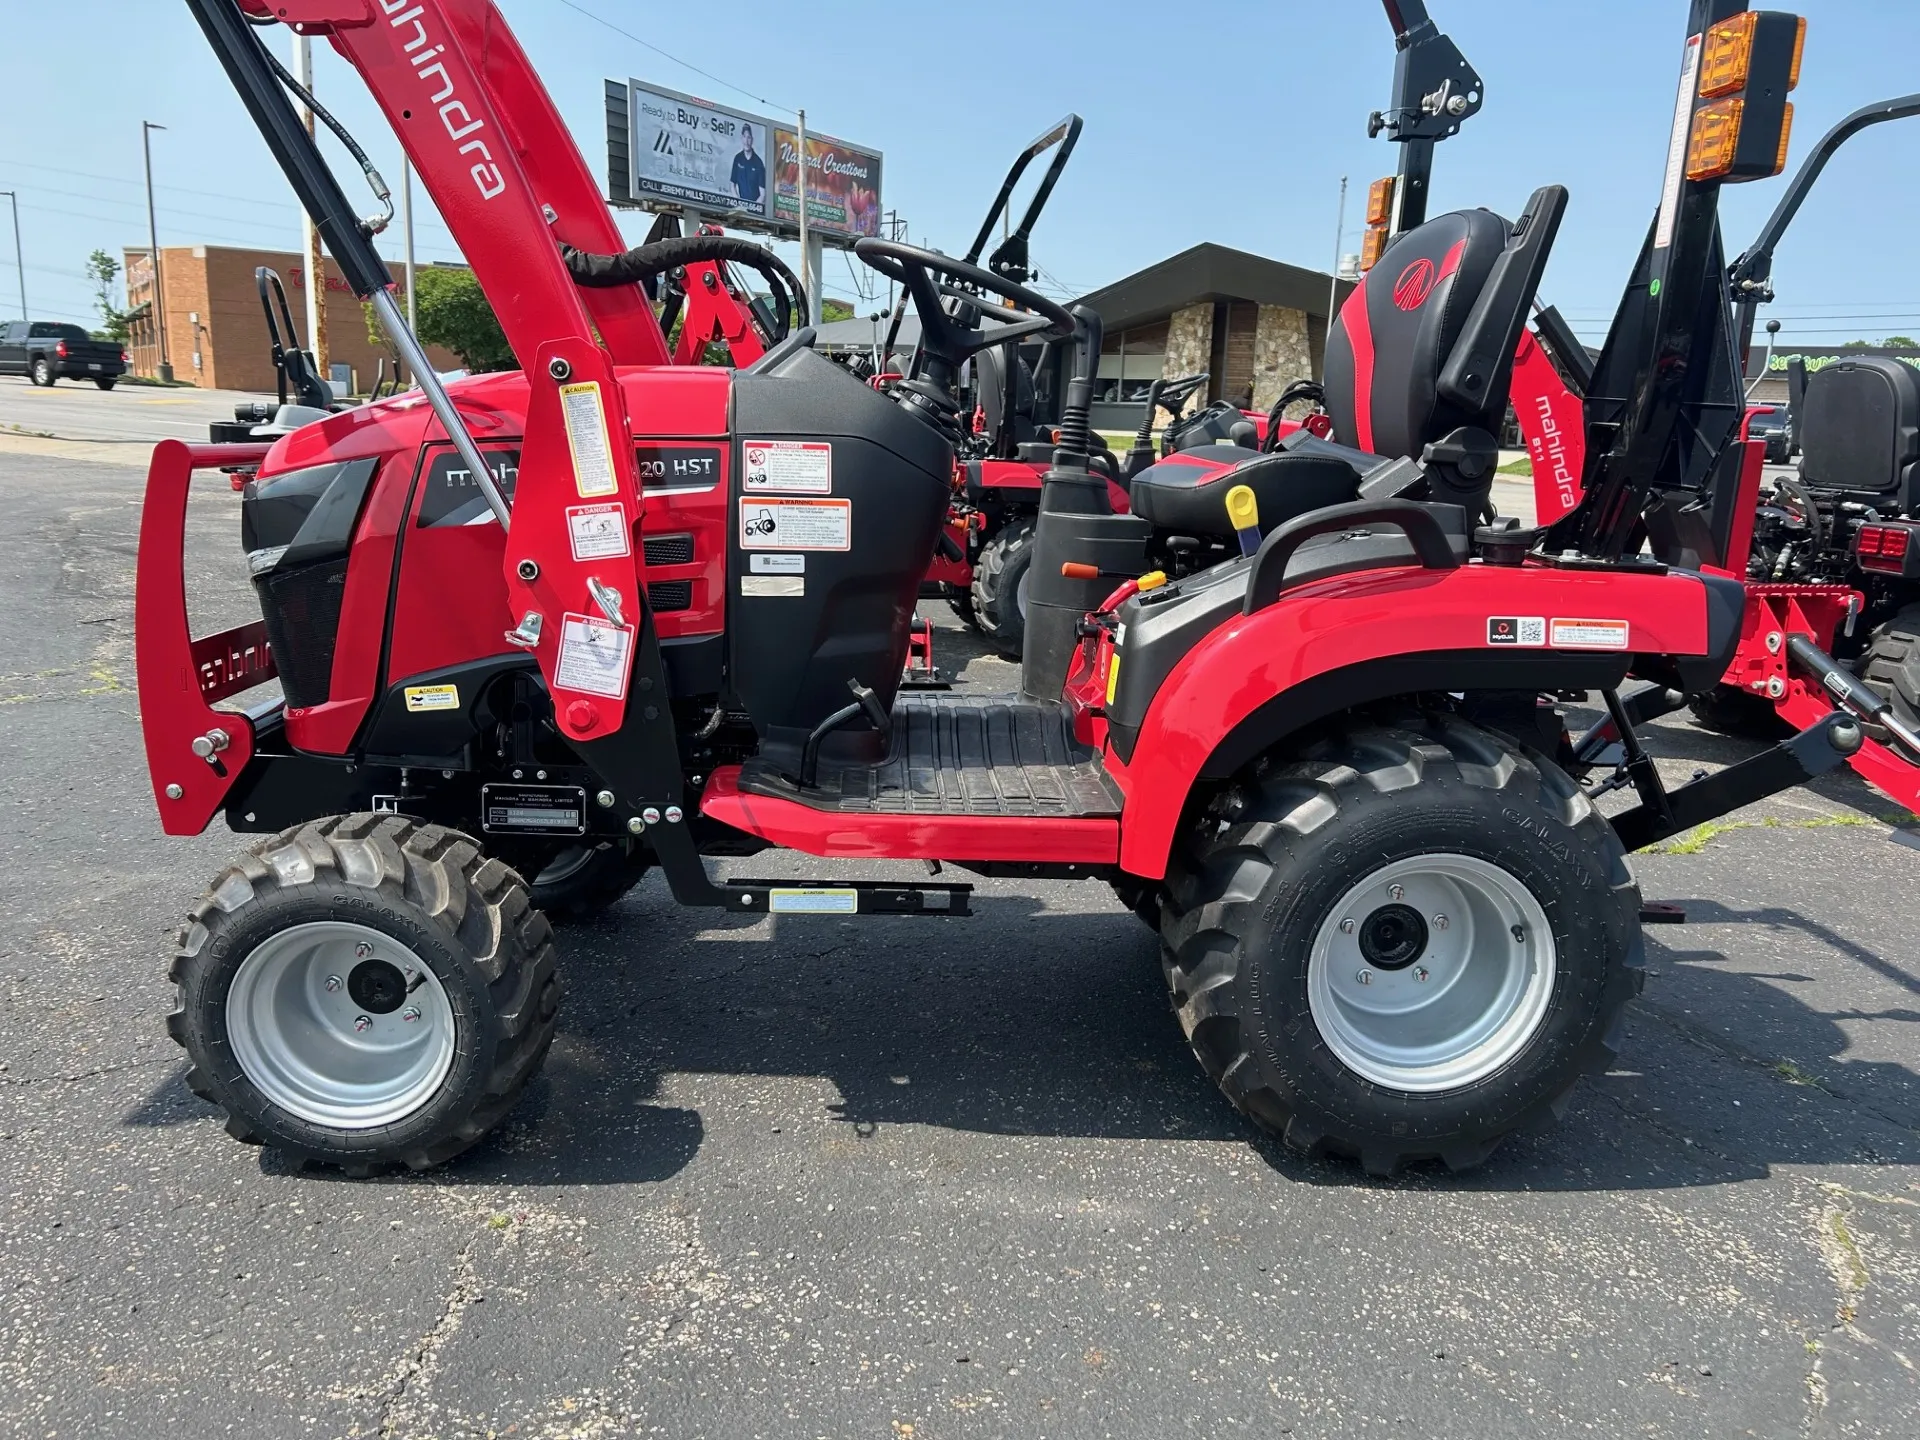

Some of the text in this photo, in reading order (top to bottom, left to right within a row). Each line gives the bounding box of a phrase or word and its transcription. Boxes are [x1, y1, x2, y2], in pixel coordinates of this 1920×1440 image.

[641, 102, 666, 121] Ready
[668, 111, 676, 122] to
[677, 107, 699, 130] Buy
[710, 117, 736, 137] Sell?
[678, 135, 714, 155] MILLS
[780, 142, 869, 179] Naral Creations
[641, 180, 659, 192] CALL
[660, 183, 685, 198] JEREMY
[685, 189, 704, 201] MILLS
[777, 195, 799, 206] NURSER
[806, 201, 827, 213] PENING
[569, 385, 595, 393] CAUTION
[1535, 395, 1575, 509] mahindra
[673, 458, 714, 476] HST
[583, 506, 613, 515] DANGER
[588, 620, 615, 630] DANGER
[1501, 807, 1594, 890] GALAXY
[1261, 879, 1289, 922] R-4
[333, 893, 429, 935] GALAXY
